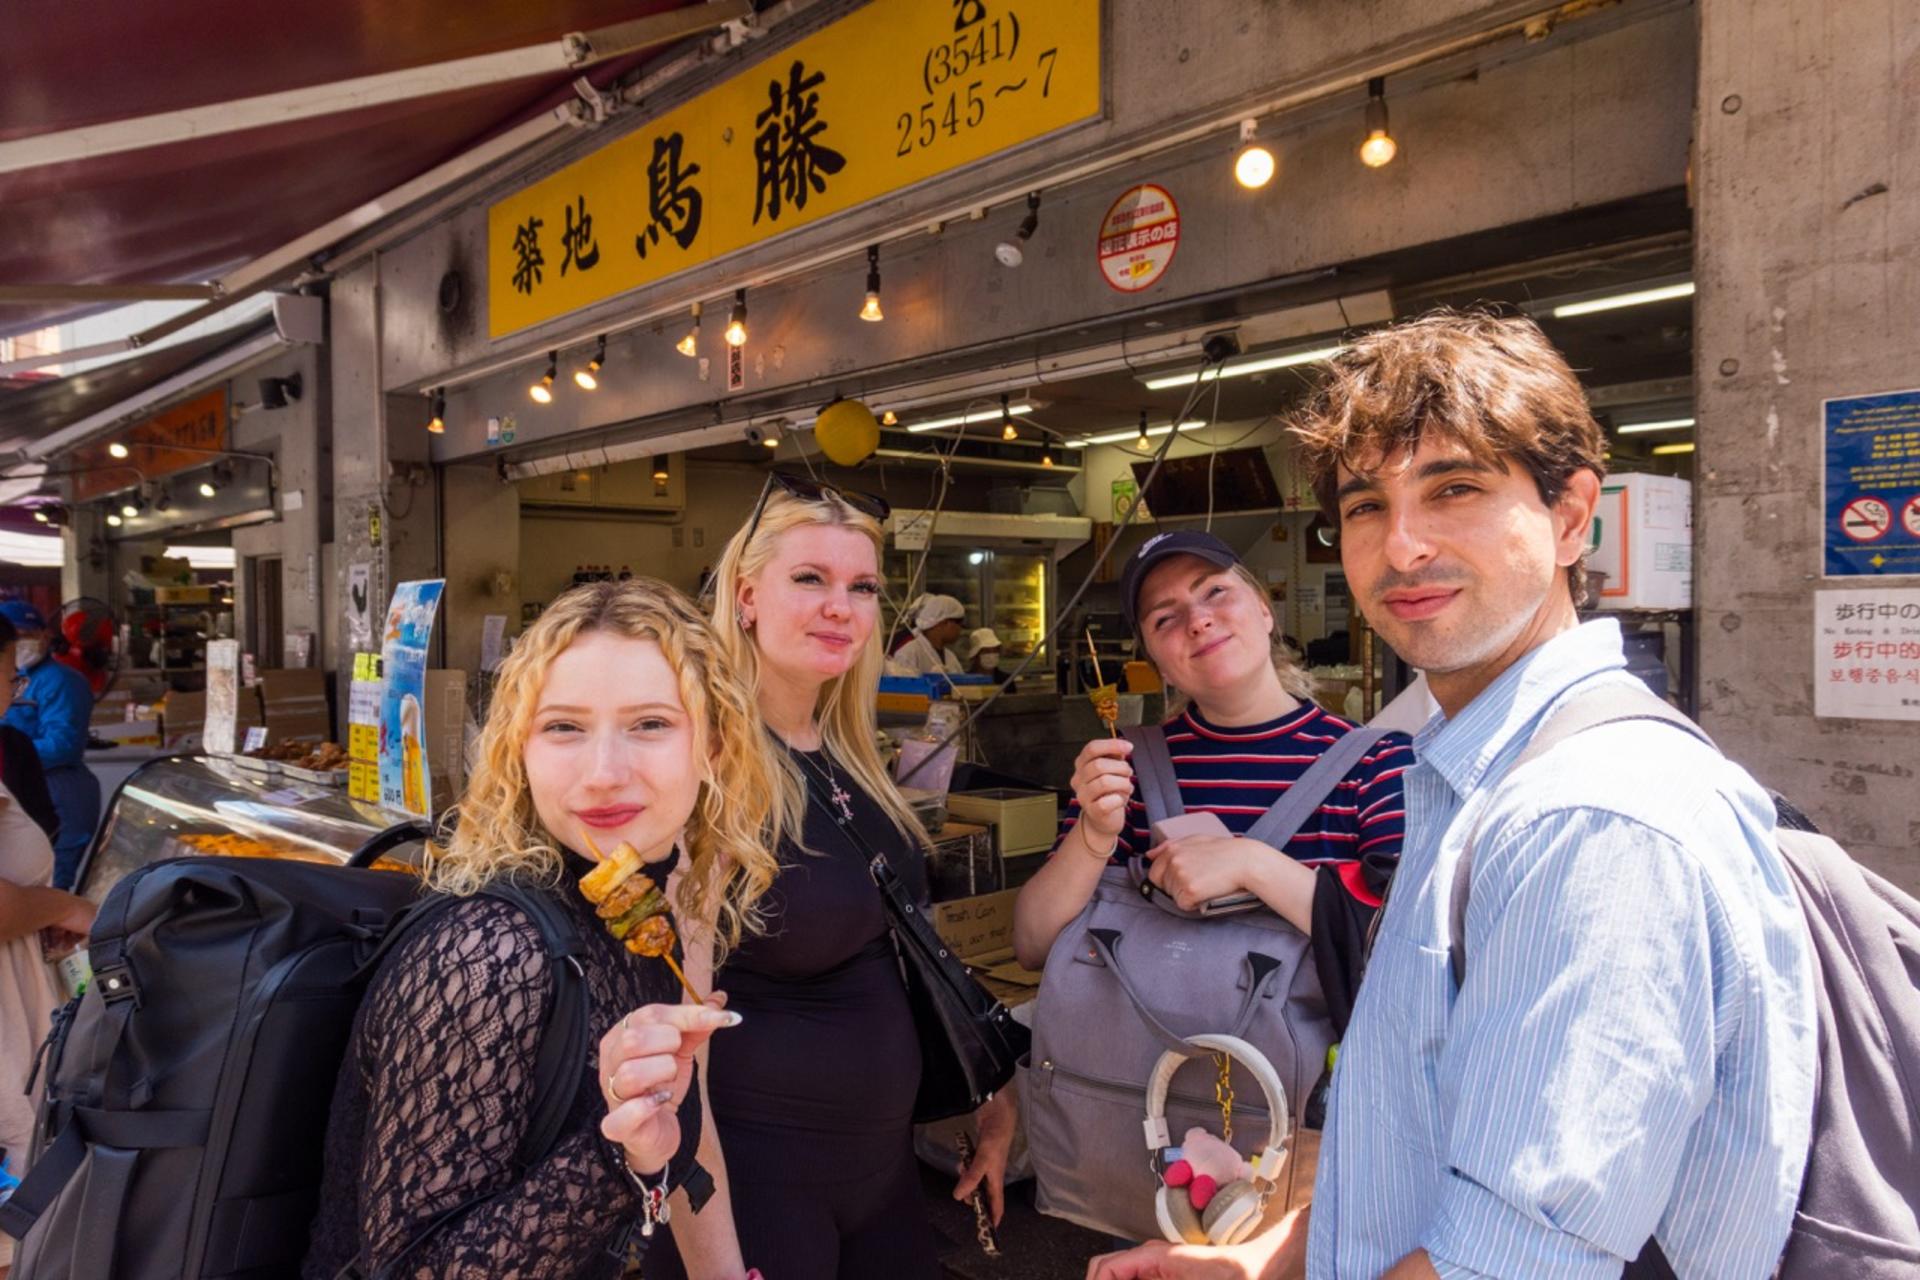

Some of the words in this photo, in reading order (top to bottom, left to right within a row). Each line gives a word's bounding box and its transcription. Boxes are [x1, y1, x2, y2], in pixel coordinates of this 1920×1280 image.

[923, 11, 1020, 95] (3541)
[1836, 602, 1920, 620] 歩行中の
